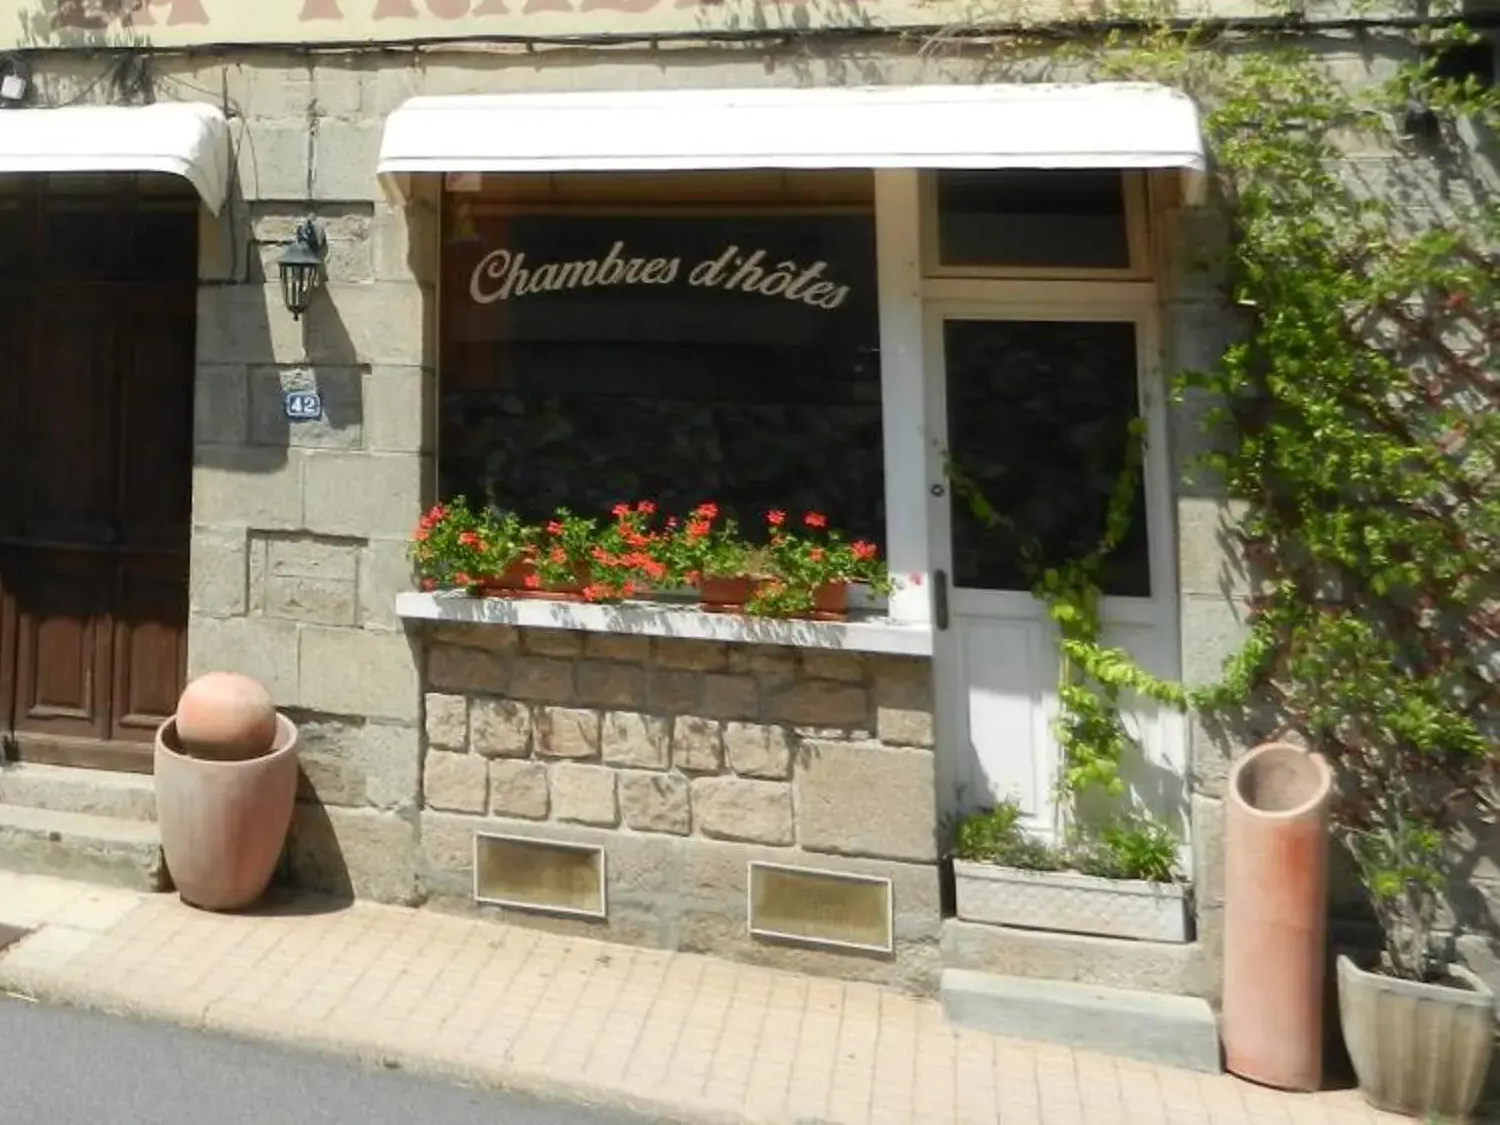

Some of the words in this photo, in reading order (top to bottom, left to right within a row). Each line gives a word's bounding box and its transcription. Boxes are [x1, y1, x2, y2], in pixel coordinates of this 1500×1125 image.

[469, 240, 682, 305] Chambres
[689, 244, 852, 309] d'hôtes
[291, 395, 316, 413] 42
